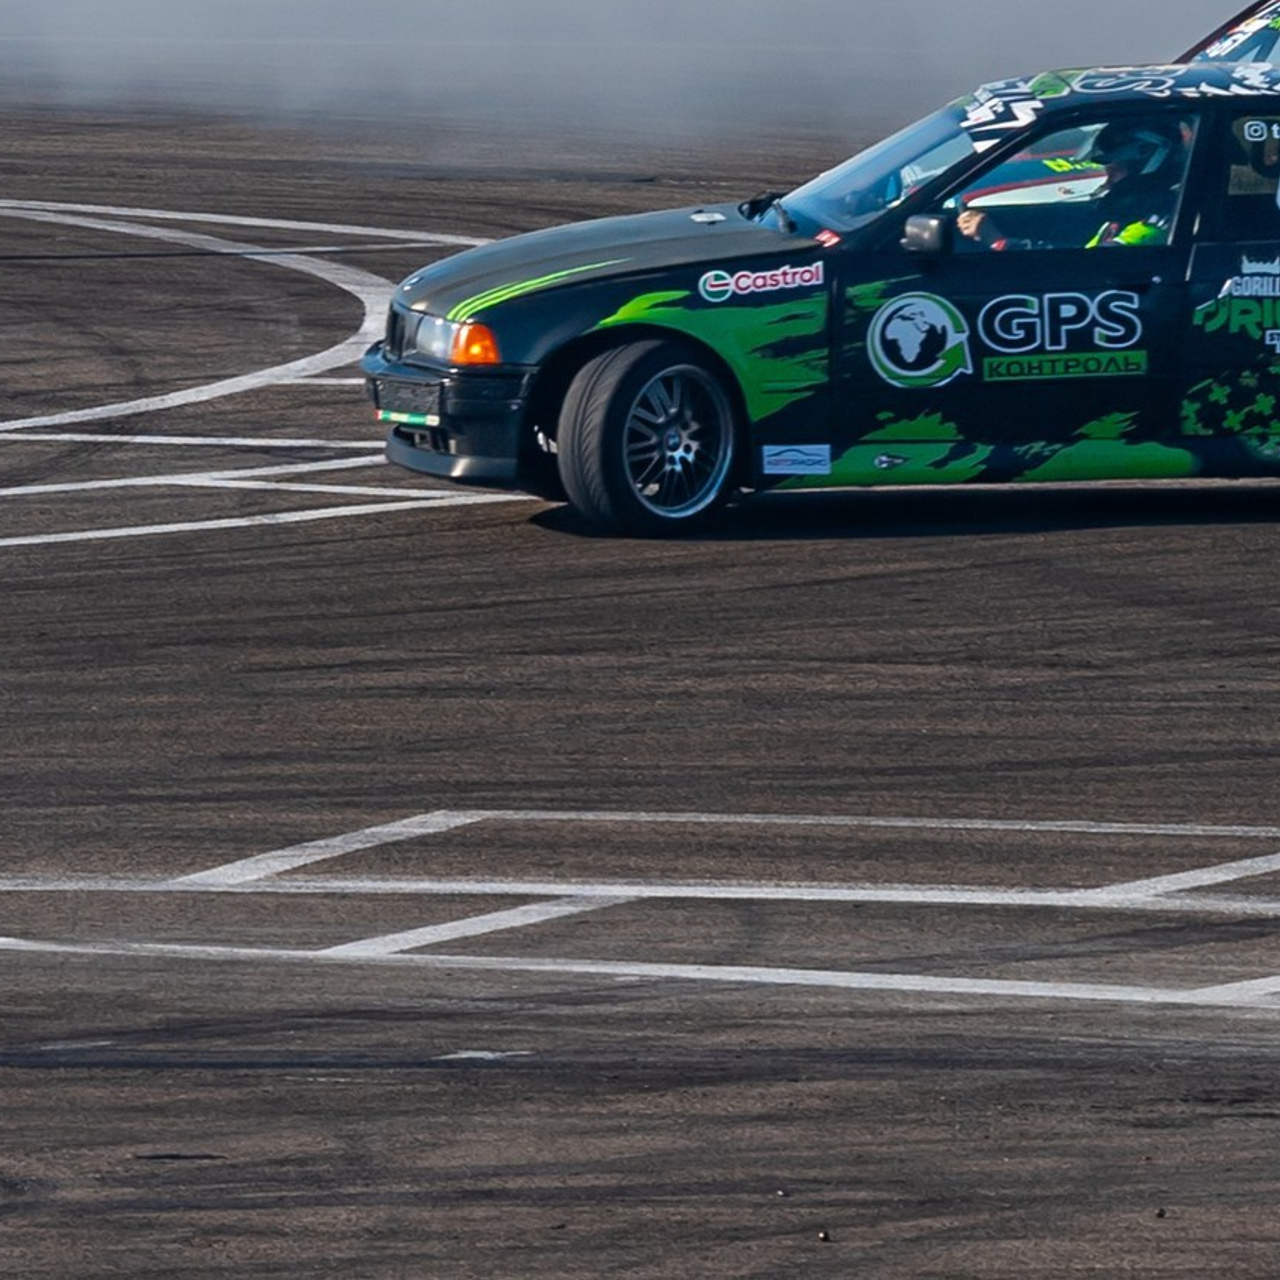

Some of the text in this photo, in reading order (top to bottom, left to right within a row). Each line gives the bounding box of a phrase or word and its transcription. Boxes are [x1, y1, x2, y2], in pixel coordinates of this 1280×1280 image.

[734, 262, 823, 293] Castrol
[977, 289, 1143, 353] GPS
[987, 354, 1142, 379] КОНТРОЛЬ
